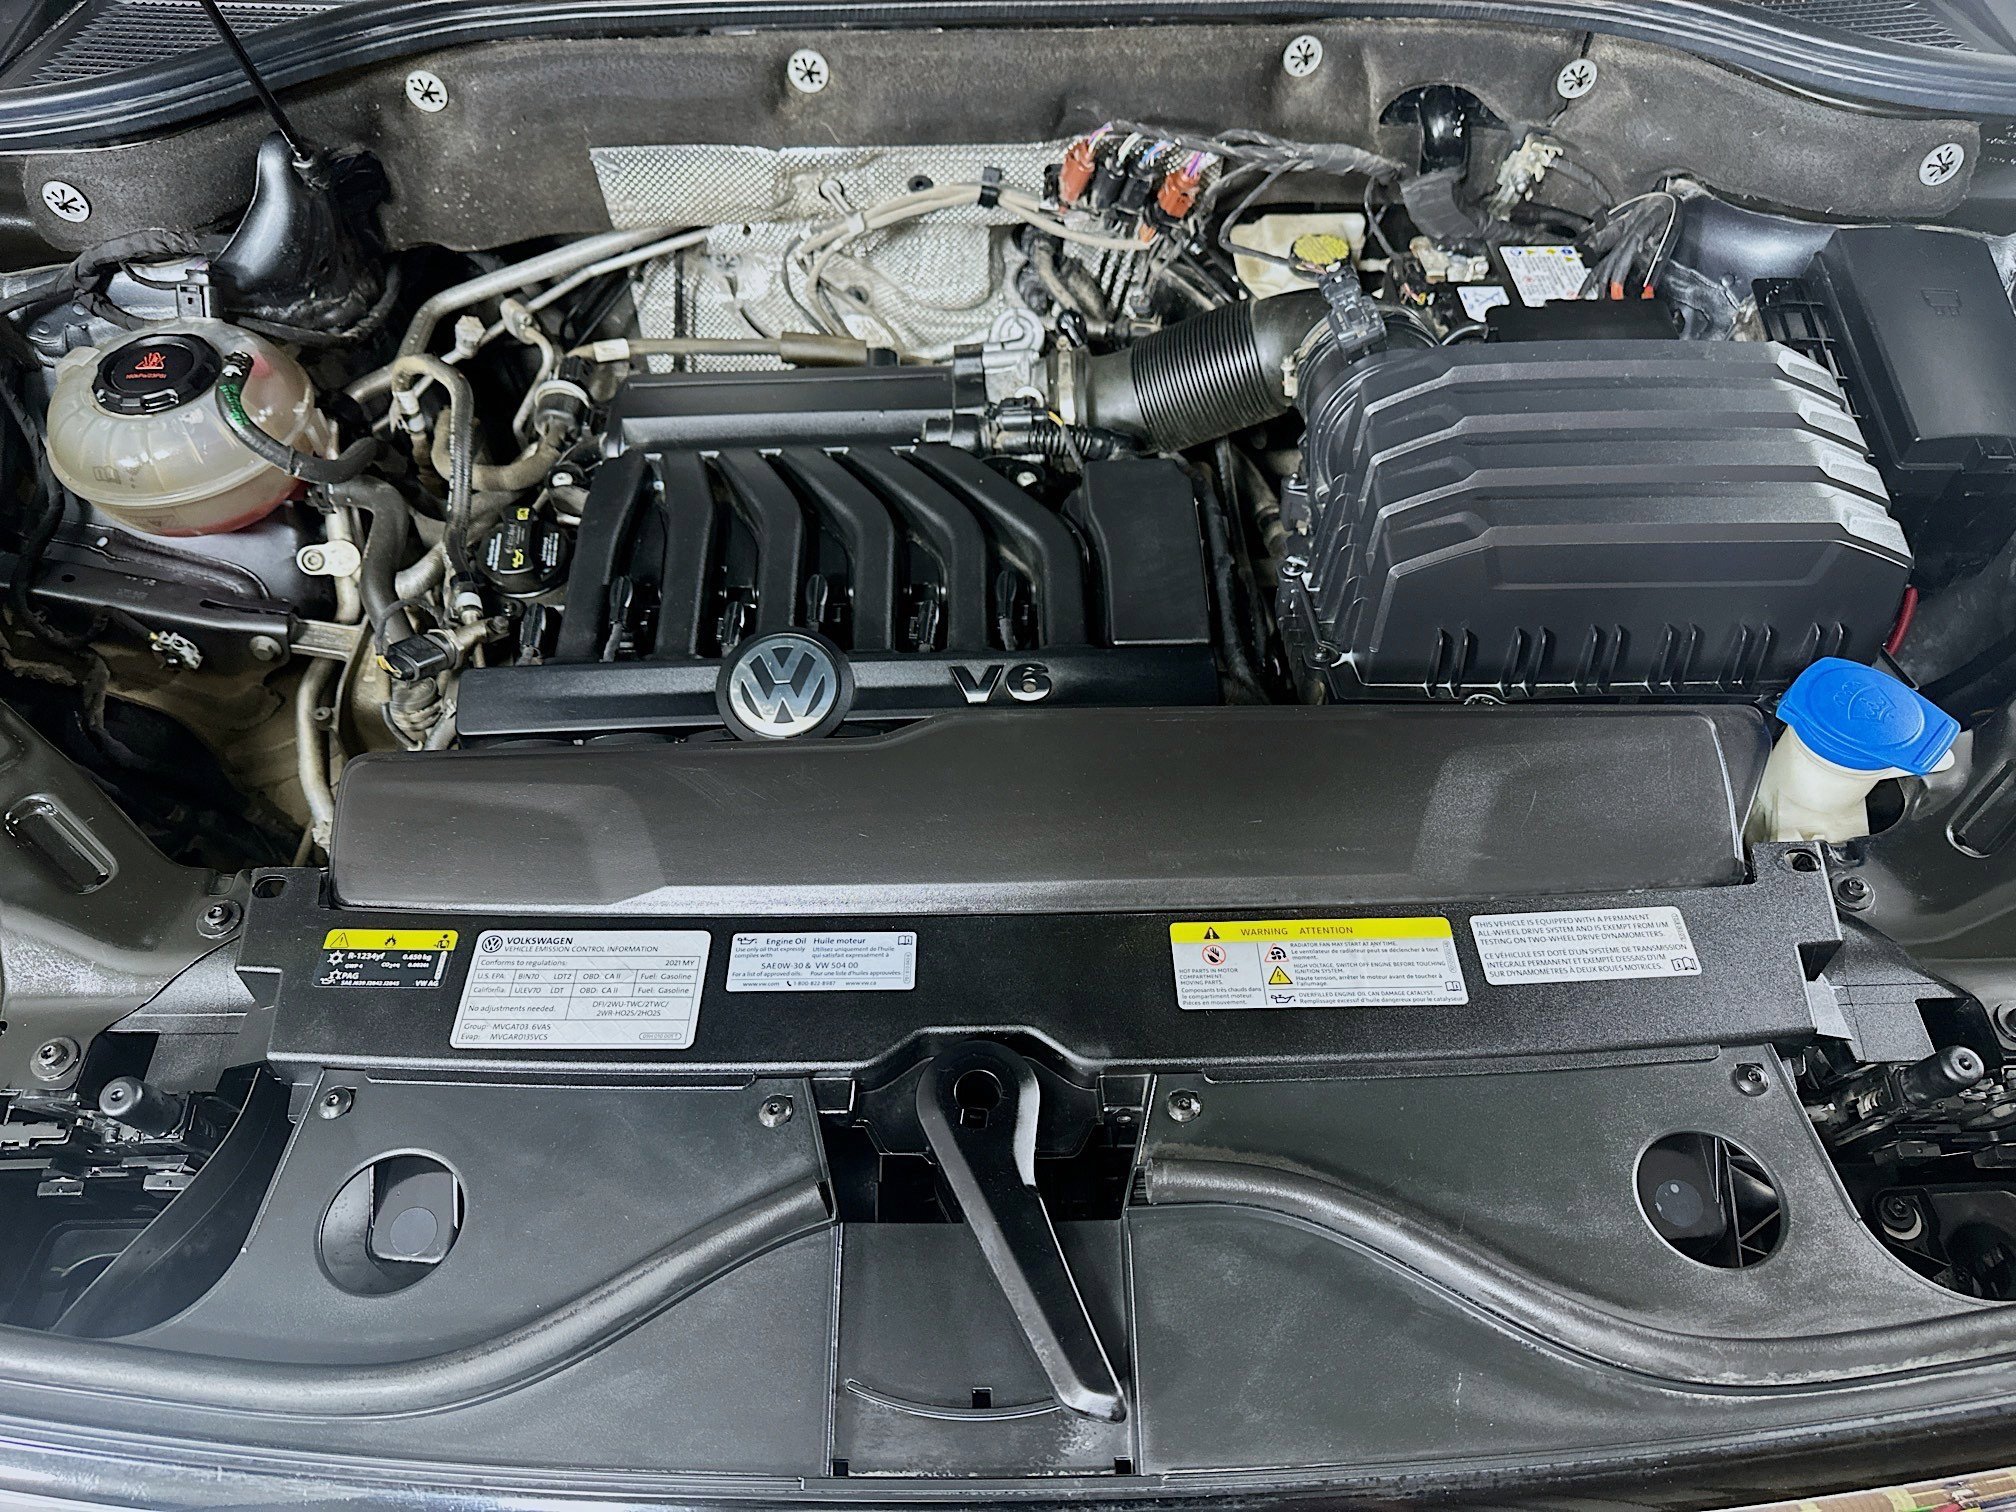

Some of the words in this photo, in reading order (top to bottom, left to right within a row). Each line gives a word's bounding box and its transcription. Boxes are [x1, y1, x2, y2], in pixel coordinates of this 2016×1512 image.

[949, 663, 1053, 704] V6
[1535, 918, 1573, 926] EQUIPPED
[1604, 914, 1649, 922] PERMANENT
[1240, 928, 1288, 936] WARNING
[1478, 928, 1520, 937] ALL-WHEEL
[1522, 927, 1544, 935] DRIVE
[1603, 923, 1631, 931] EXEMPT
[766, 938, 793, 946] Engine
[1480, 938, 1512, 946] TESTING
[1528, 935, 1575, 944] TWO-WHEEL
[347, 952, 386, 961] R-1234yf
[1495, 950, 1532, 959] VÉHICULE
[1568, 947, 1588, 955] D'UN
[1588, 946, 1620, 955] SYSTÈME
[1633, 944, 1687, 952] TRANSMISSION
[1487, 960, 1526, 969] INTÉGRALE
[1527, 958, 1573, 967] PERMANENT
[1583, 956, 1614, 964] EXEMPTÉ
[342, 972, 359, 980] PAG
[1506, 967, 1568, 977] DYNAMOMÈTRES
[1576, 965, 1598, 974] DEUX
[1599, 964, 1624, 972] ROUES
[480, 1005, 525, 1013] adjustments
